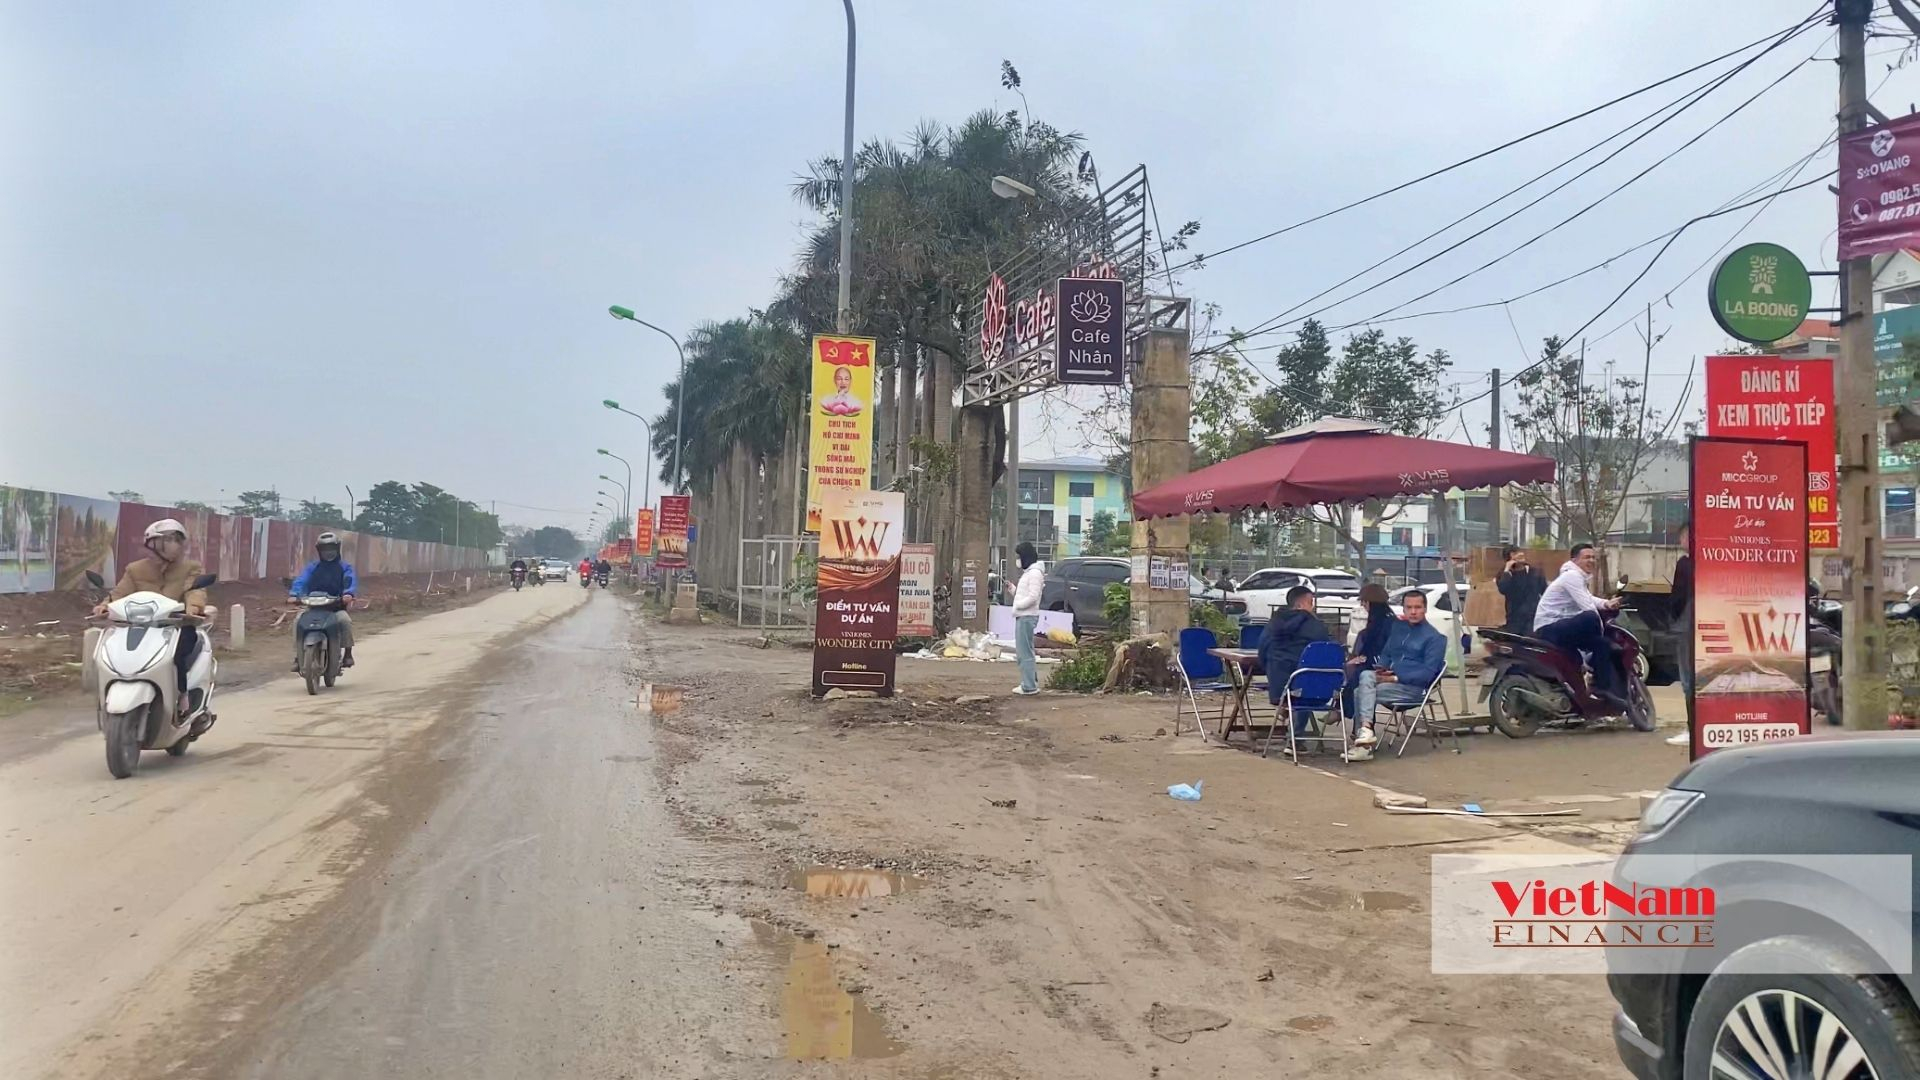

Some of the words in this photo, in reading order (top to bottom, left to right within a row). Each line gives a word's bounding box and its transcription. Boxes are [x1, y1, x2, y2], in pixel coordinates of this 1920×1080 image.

[1879, 155, 1911, 175] VANG
[1015, 288, 1051, 344] Cafe
[1724, 299, 1746, 316] LA
[1748, 302, 1799, 318] BOONG
[1071, 328, 1111, 344] Cafe
[1069, 349, 1112, 365] Nhân
[1741, 365, 1781, 392] ĐĂNG
[1785, 364, 1800, 392] KÍ
[1718, 404, 1751, 427] XEM
[1754, 402, 1792, 431] TRỰC
[1794, 396, 1825, 426] TIẾP
[1415, 469, 1449, 480] VHS
[1721, 473, 1778, 484] MICCGROUP
[1195, 489, 1215, 501] VHS
[1705, 488, 1741, 510] ĐIỂM
[1744, 495, 1765, 510] TƯ
[1766, 492, 1794, 511] VẤN
[1729, 536, 1771, 545] VINHOMES
[1702, 547, 1764, 562] WONDER
[1767, 549, 1798, 563] CITY
[852, 602, 869, 612] TƯ
[869, 601, 891, 612] VẤN
[841, 613, 857, 624] DỰ
[858, 613, 874, 623] ÁN
[817, 637, 867, 649] WONDER
[869, 639, 895, 650] CITY
[842, 662, 867, 670] Hotline
[1735, 712, 1768, 721] HOTLINE
[1707, 729, 1733, 744] 092
[1737, 729, 1759, 743] 195
